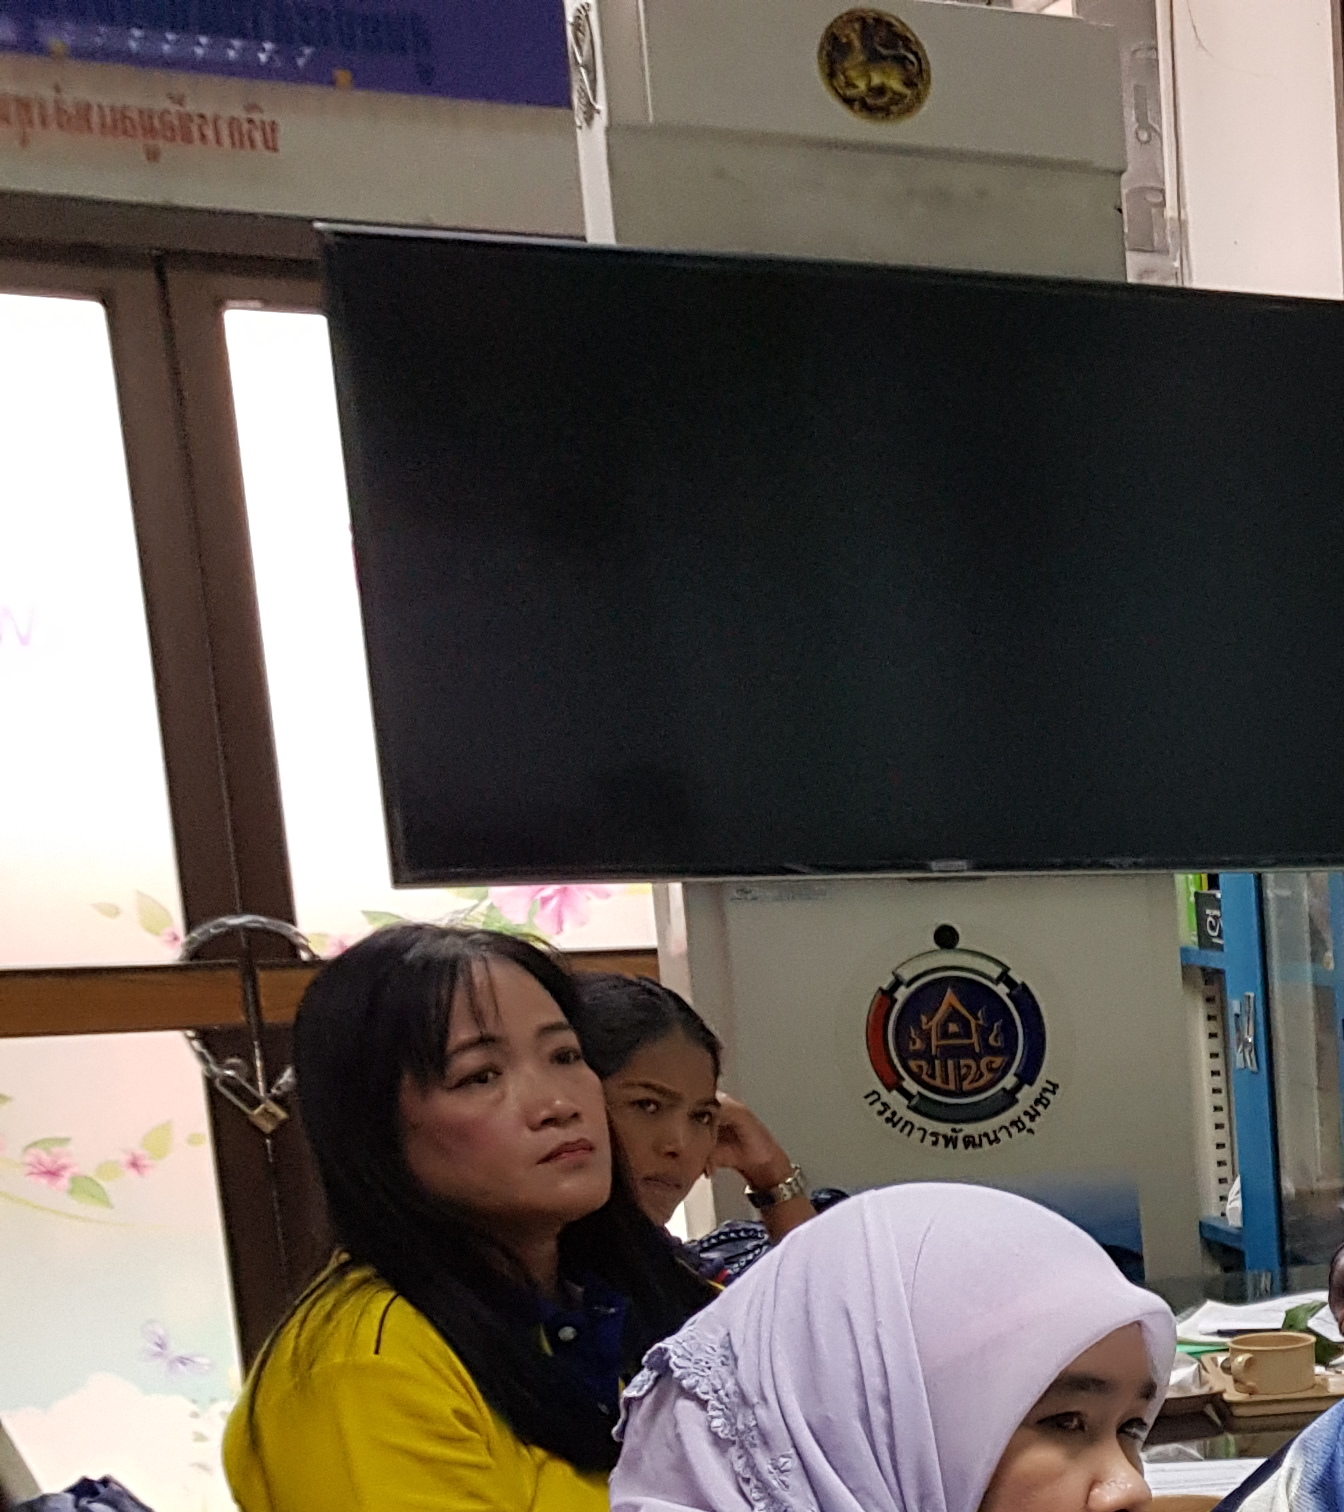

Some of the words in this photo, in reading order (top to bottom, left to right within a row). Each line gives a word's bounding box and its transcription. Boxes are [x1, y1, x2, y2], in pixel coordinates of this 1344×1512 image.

[863, 1079, 1060, 1150] กรมการพัฒนาชุมชน
